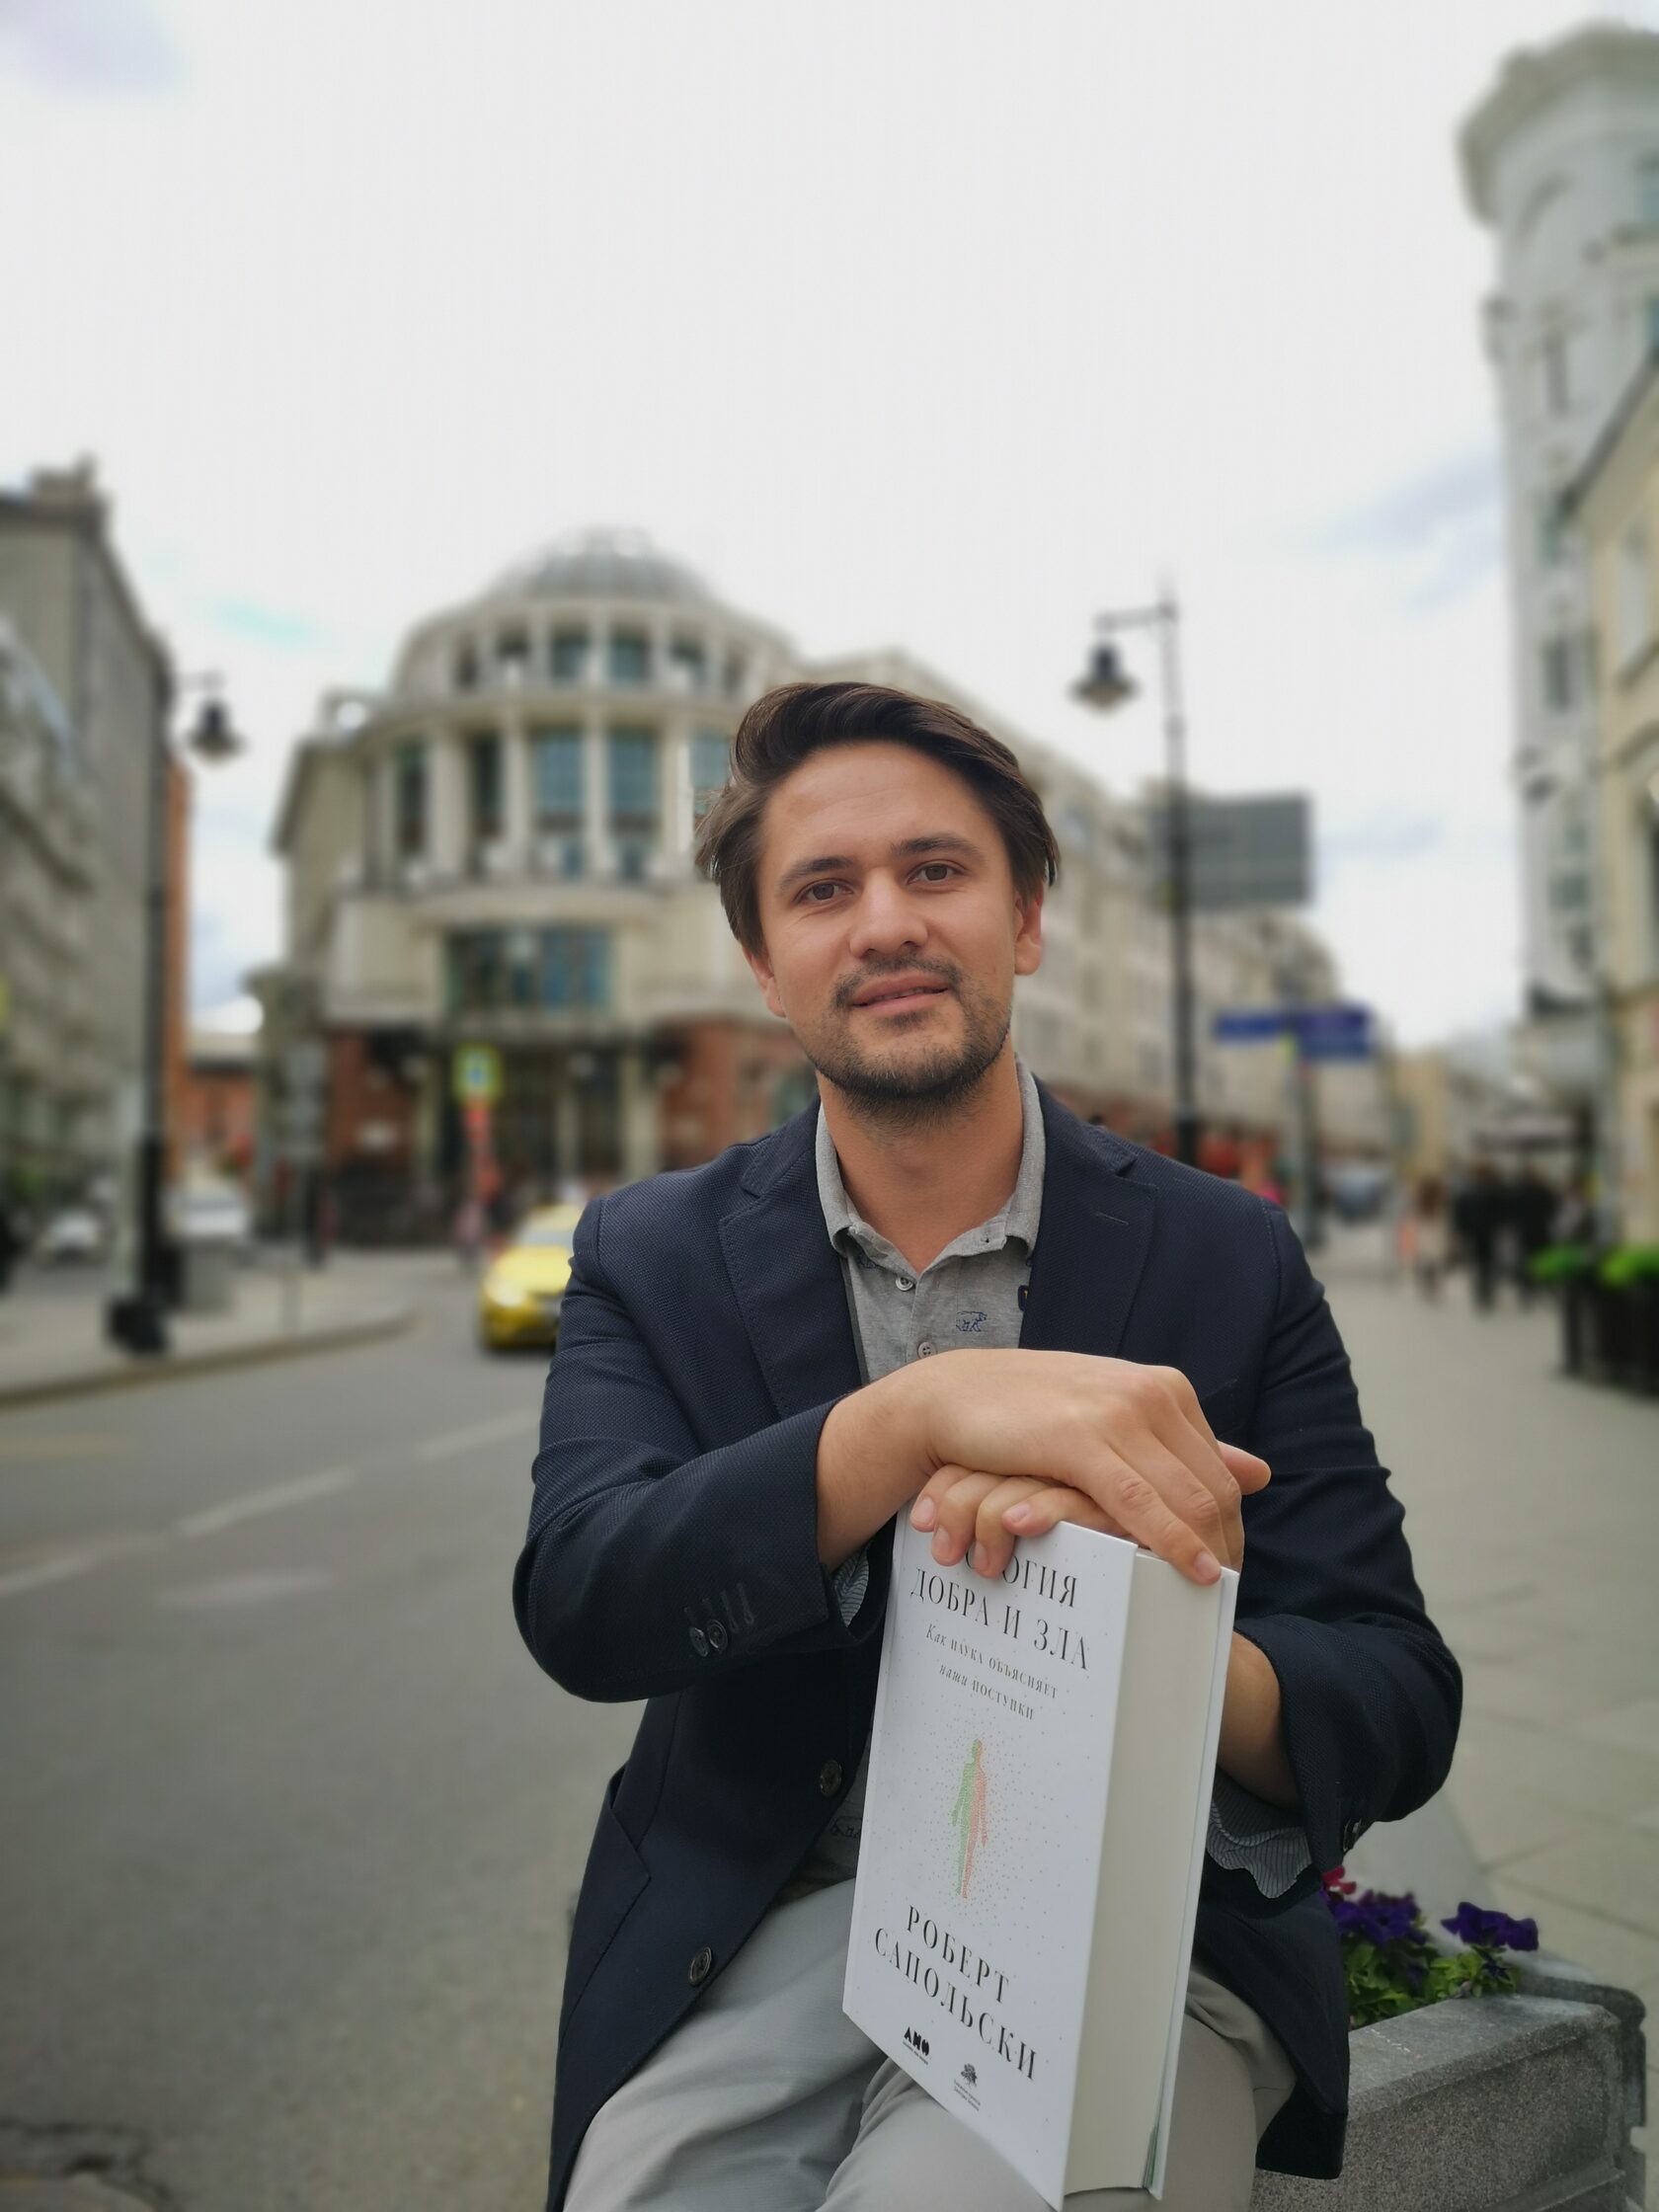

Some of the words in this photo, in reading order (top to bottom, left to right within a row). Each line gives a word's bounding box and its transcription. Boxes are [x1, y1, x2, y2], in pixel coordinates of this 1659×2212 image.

[910, 1567, 988, 1626] ДОБРА
[1003, 1605, 1021, 1639] И
[1034, 1620, 1087, 1671] ЗЛА
[966, 1550, 1077, 1608] ОГИЯ
[926, 1623, 947, 1646] Как
[907, 1905, 1009, 2004] РОБЕРТ
[875, 1928, 1037, 2081] САПОЛЬСКИ
